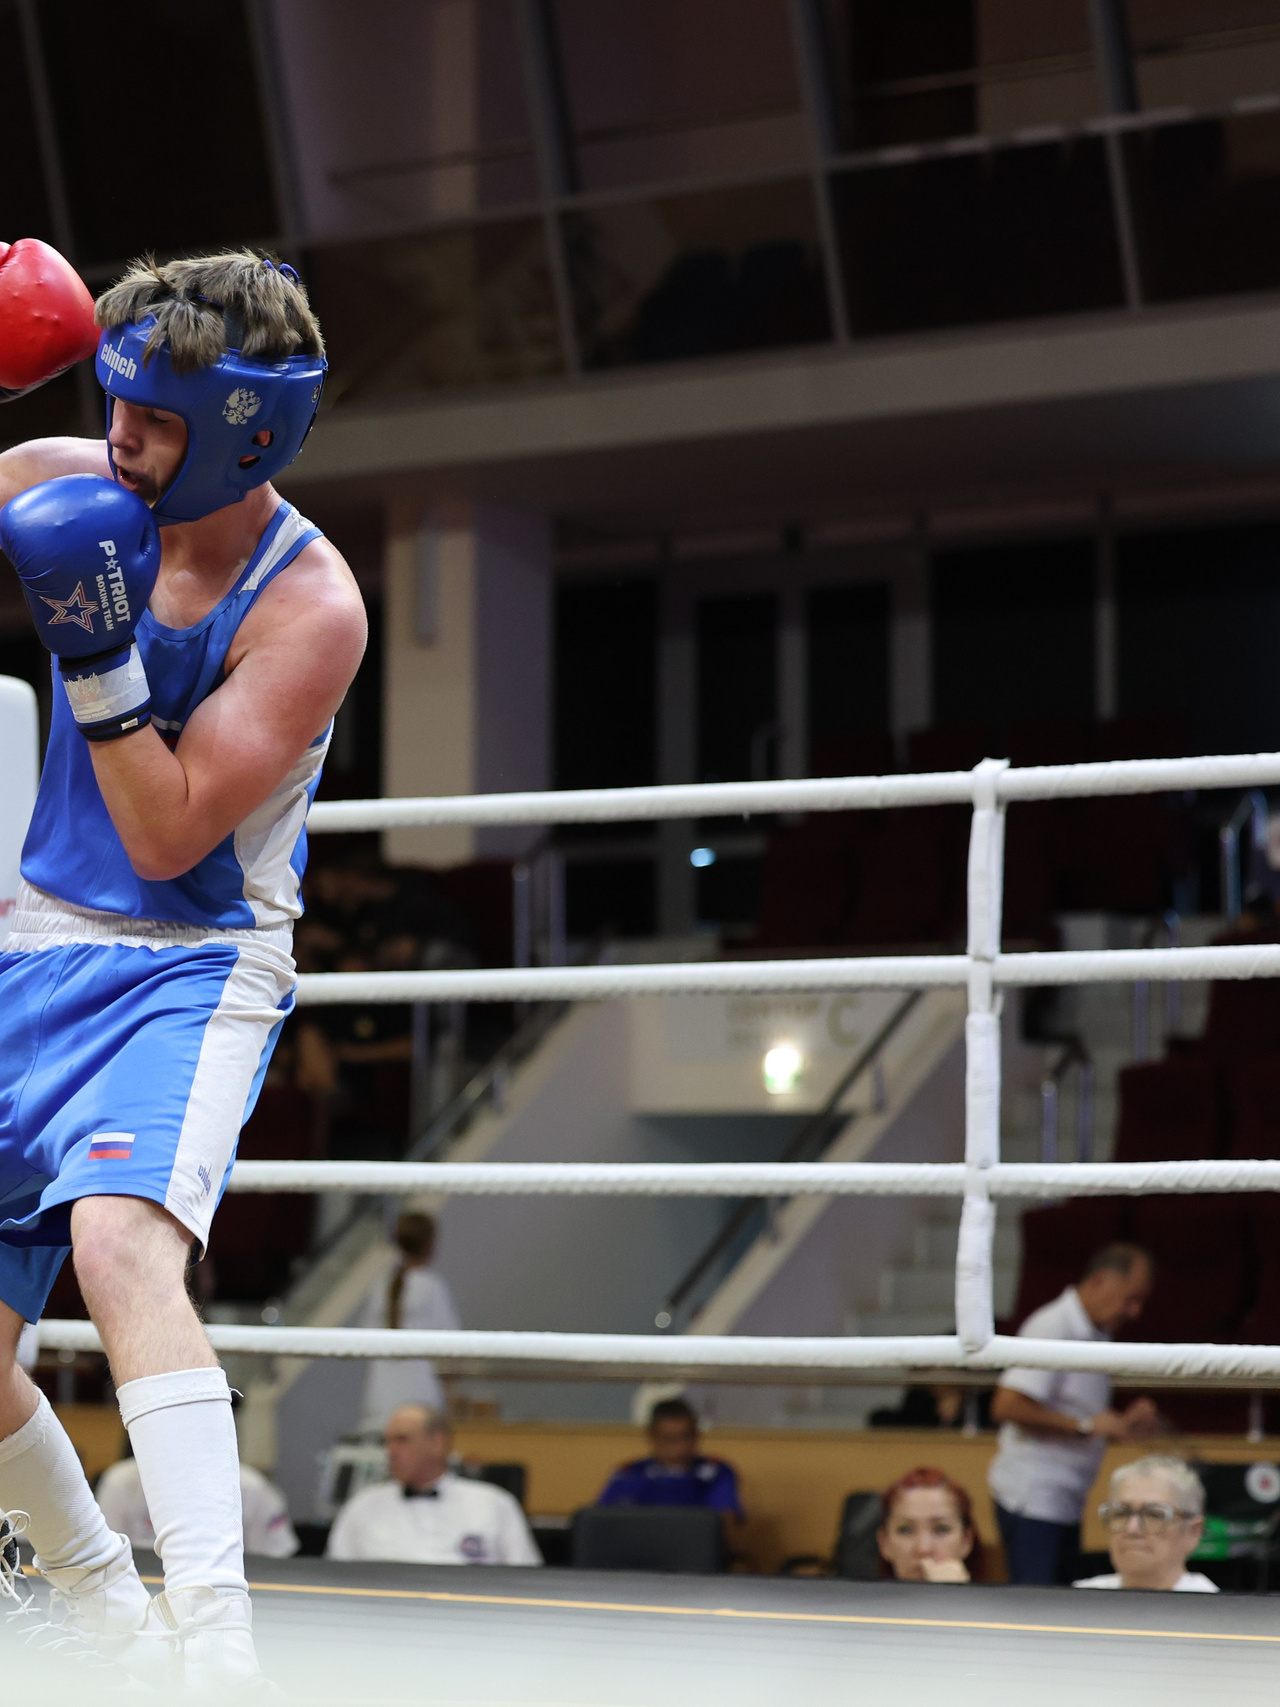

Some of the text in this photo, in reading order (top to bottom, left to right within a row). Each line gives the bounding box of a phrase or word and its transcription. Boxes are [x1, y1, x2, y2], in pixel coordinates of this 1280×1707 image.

[101, 342, 137, 381] clinch
[95, 574, 114, 631] BOXING TEAM
